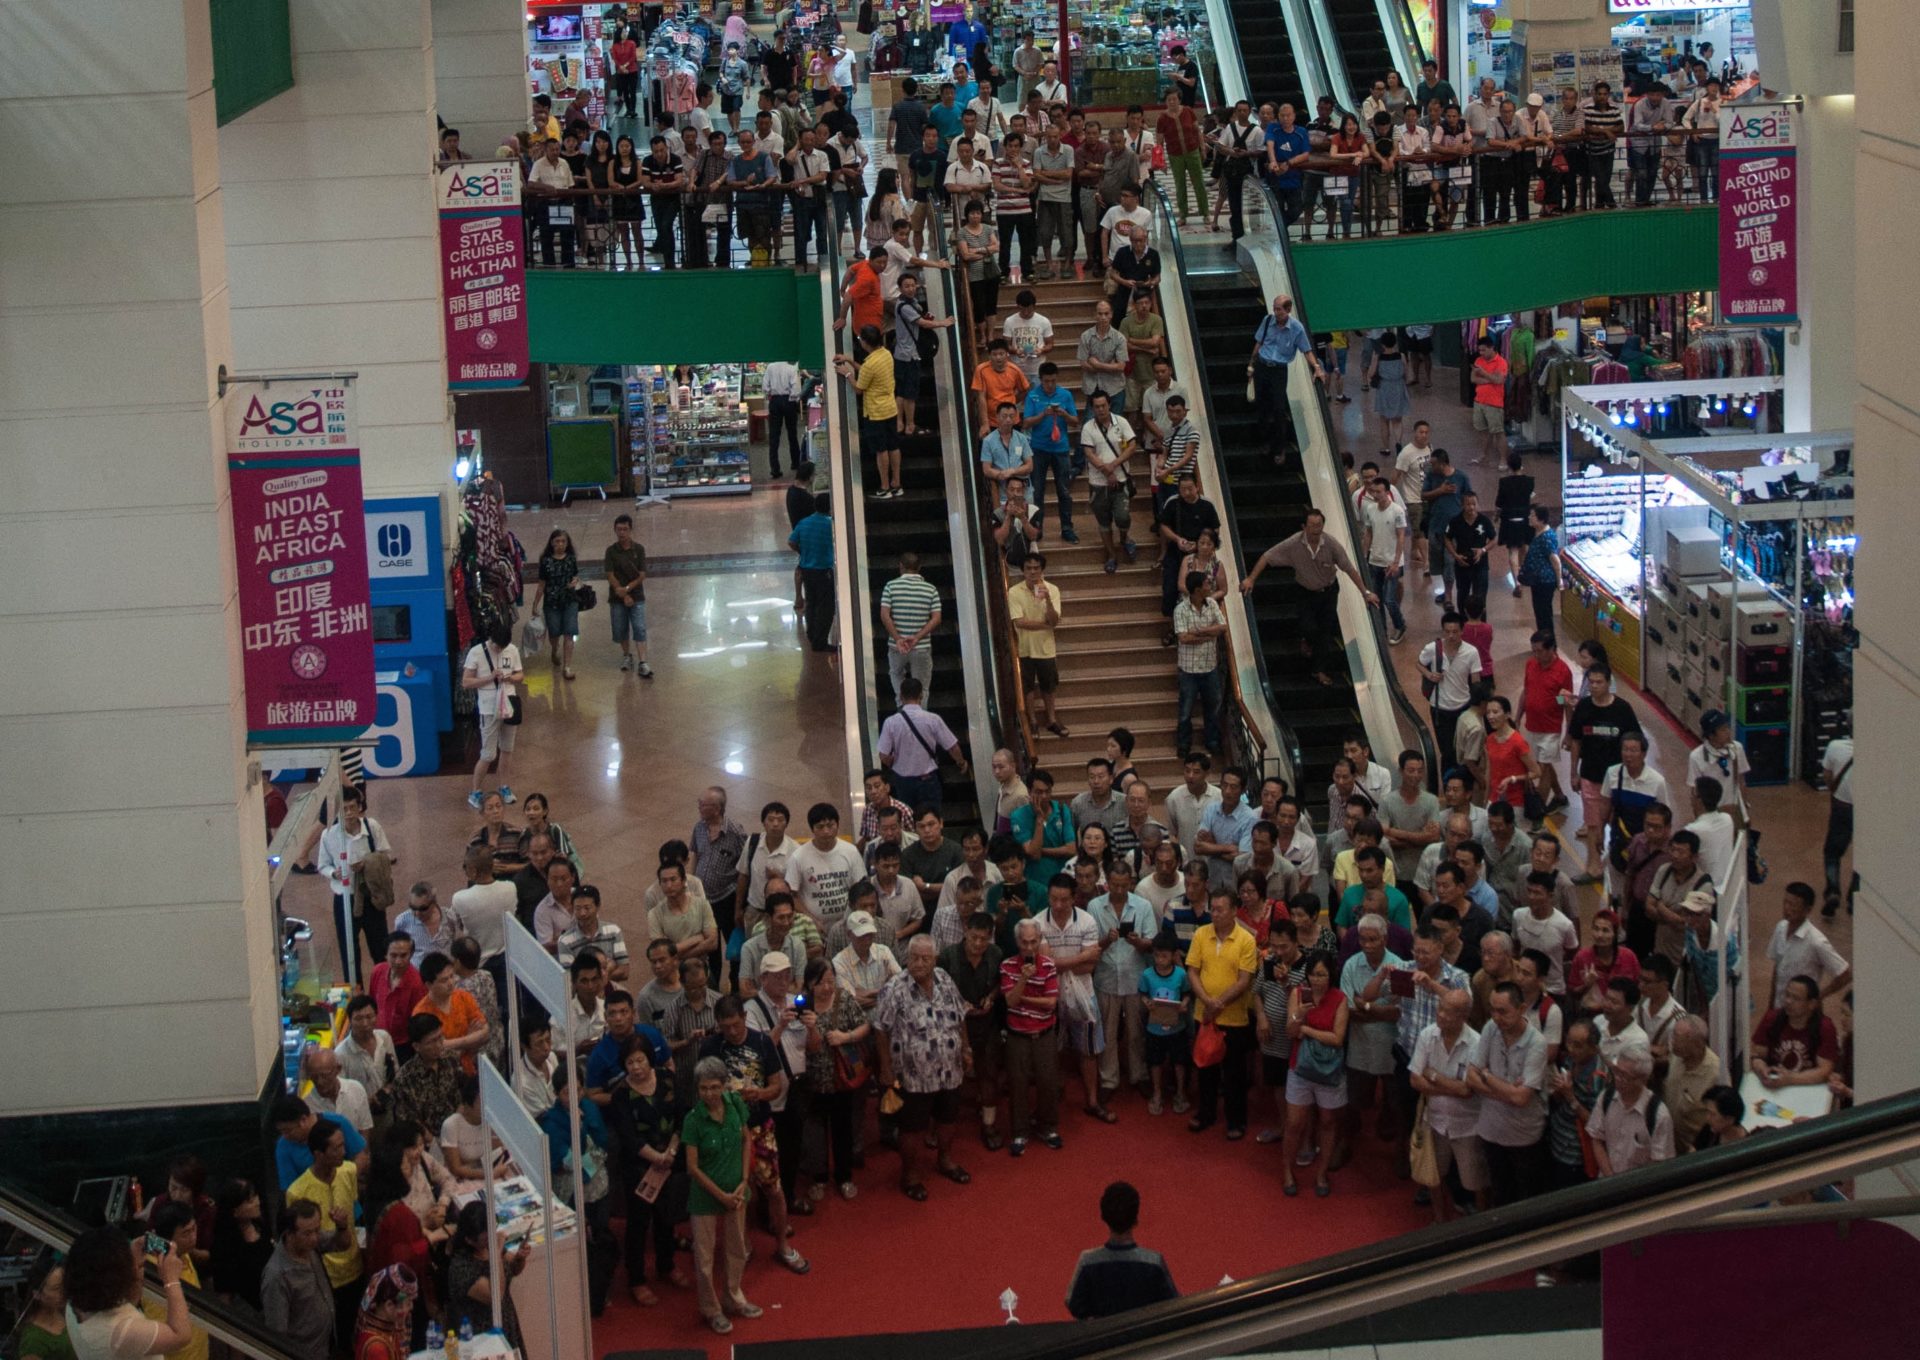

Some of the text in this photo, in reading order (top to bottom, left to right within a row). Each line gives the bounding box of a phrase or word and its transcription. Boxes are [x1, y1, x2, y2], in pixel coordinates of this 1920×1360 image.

[1727, 114, 1777, 139] Asa
[447, 172, 499, 197] Asa
[1725, 167, 1791, 191] AROUND
[1742, 184, 1774, 200] THE
[1732, 195, 1790, 217] WORLD
[460, 229, 504, 248] STAR
[1734, 225, 1773, 249] 环游
[450, 240, 515, 263] CRUISES
[1750, 240, 1787, 264] 世界
[450, 255, 517, 281] HK.THAI
[449, 284, 521, 315] 丽星邮轮
[454, 305, 518, 331] 香港 泰国
[460, 362, 517, 379] 旅游品牌
[240, 394, 325, 436] Asa
[239, 438, 326, 449] HOLIDAYS
[264, 475, 327, 492] Quality Tours
[264, 492, 330, 520] INDIA
[254, 510, 344, 544] M.EAST
[255, 532, 346, 565] AFRICA
[379, 559, 413, 568] CASE
[275, 581, 333, 616] 印度
[244, 603, 368, 651] 中东 非洲
[267, 699, 358, 725] 旅游品牌
